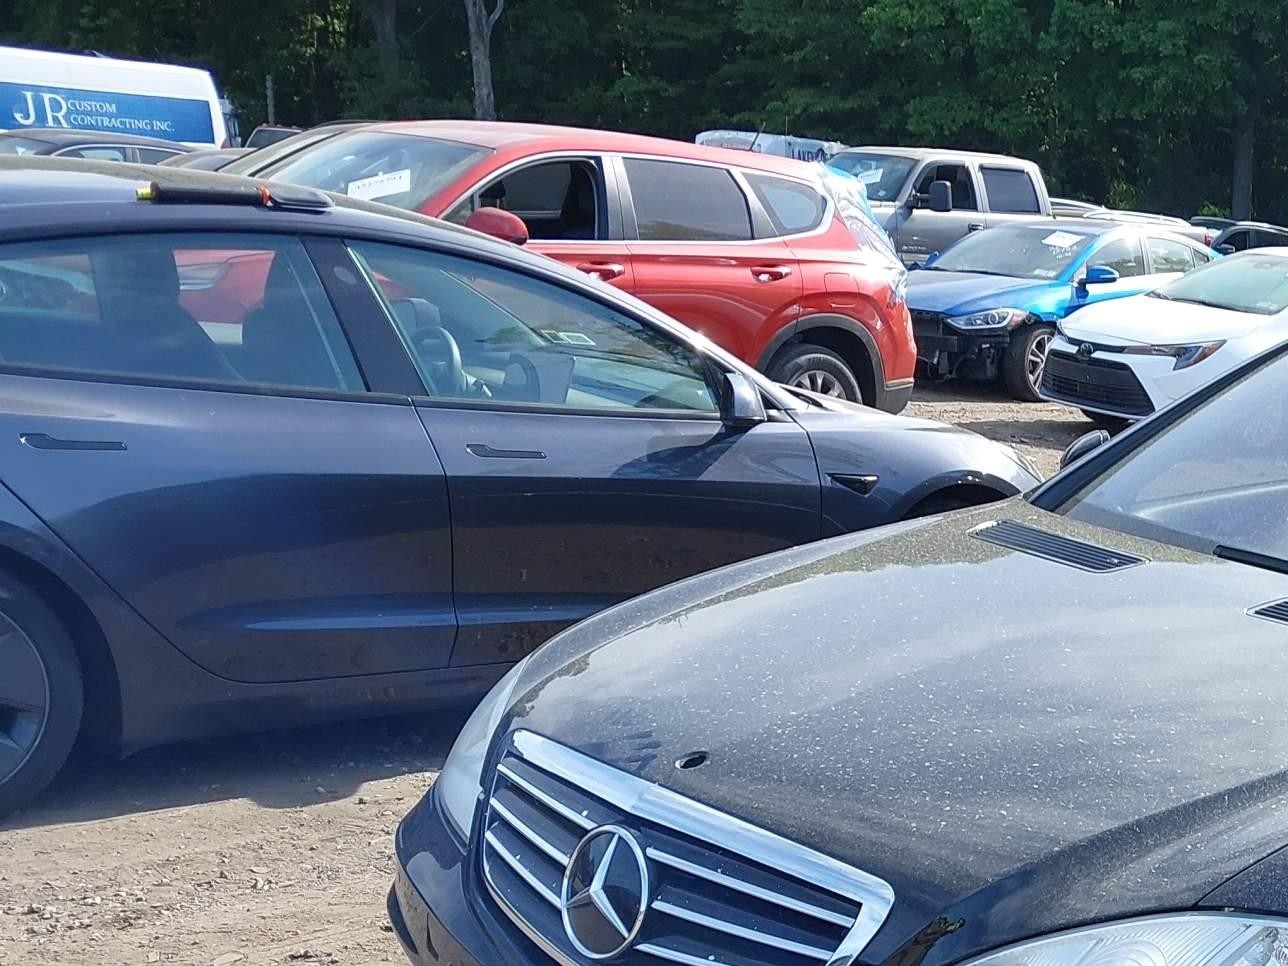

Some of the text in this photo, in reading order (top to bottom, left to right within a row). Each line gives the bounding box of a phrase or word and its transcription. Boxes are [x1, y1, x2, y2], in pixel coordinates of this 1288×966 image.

[68, 100, 117, 113] CUSTOM
[70, 114, 175, 132] CONTRACTING INC.
